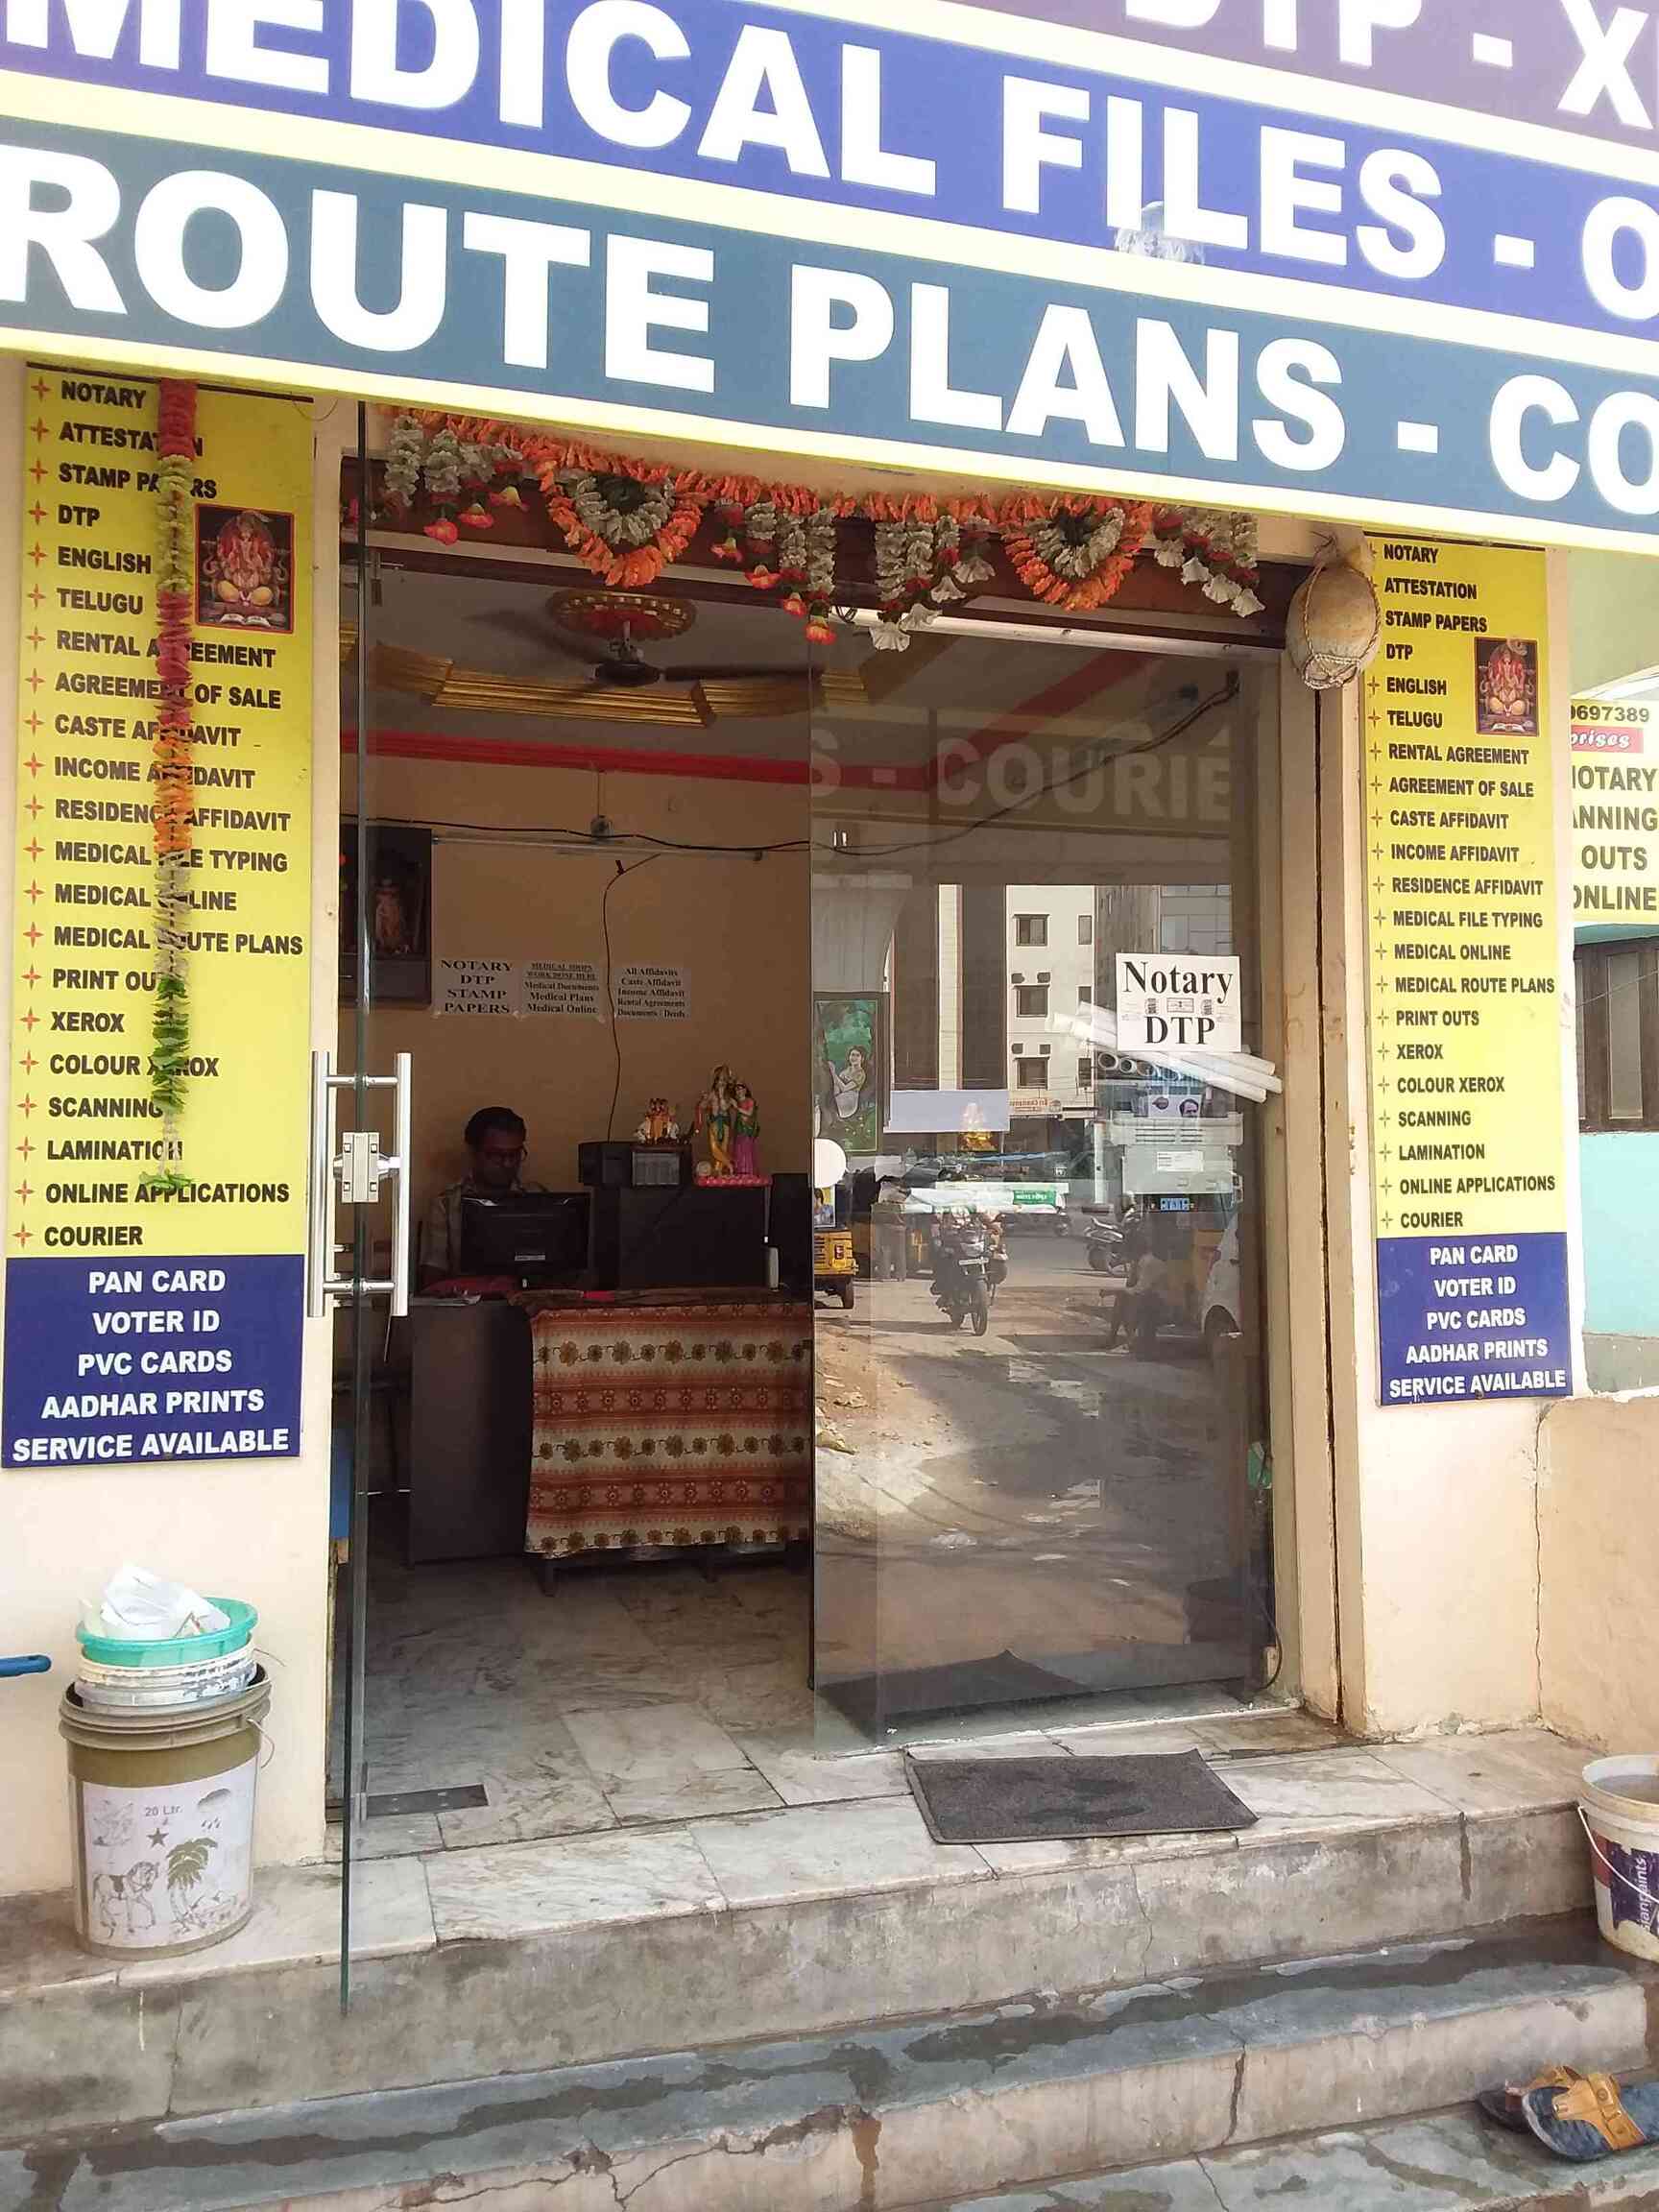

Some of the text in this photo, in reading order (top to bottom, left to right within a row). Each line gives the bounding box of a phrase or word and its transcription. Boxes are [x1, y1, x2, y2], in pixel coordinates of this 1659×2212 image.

[1002, 74, 1448, 280] FILES
[1494, 233, 1535, 269] -
[0, 144, 1659, 517] ROUTE PLANS - CO
[61, 380, 146, 409] NOTARY
[59, 422, 204, 457] ATTESTAN
[59, 464, 217, 499] STAMP PARS
[58, 504, 101, 527] DTP
[58, 545, 152, 574] ENGLISH
[1383, 543, 1439, 565] NOTARY
[1383, 577, 1478, 599] ATTESTATION
[57, 588, 144, 614] TELUGU
[1385, 610, 1488, 633] STAMP PAPERS
[57, 630, 276, 668] RENTAL AEEMENT
[1385, 644, 1413, 661] DTP
[55, 672, 281, 709] AGREEME OF SALE
[1386, 677, 1447, 696] ENGLISH
[55, 714, 126, 739] CASTE
[1386, 710, 1443, 729] TELUGU
[1388, 743, 1529, 765] RENTAL AGREEMENT
[54, 757, 255, 789] INCOME ADAVIT
[1572, 764, 1659, 792] OTARY
[1389, 777, 1534, 798] AGREEMENT OF SALE
[55, 799, 291, 831] RESIDEN AFFIDAVIT
[1390, 809, 1509, 830] CASTE AFFIDAVIT
[56, 841, 152, 866] MEDICAL
[209, 850, 288, 873] TYPING
[1391, 844, 1520, 863] INCOME AFFIDAVIT
[1581, 844, 1648, 871] OUTS
[55, 883, 238, 911] MEDICAL LINE
[1392, 877, 1544, 896] RESIDENCE AFFIDAVIT
[1393, 910, 1544, 928] MEDICAL FILE TYPING
[54, 926, 151, 950] MEDICAL
[234, 934, 303, 955] PLANS
[1394, 944, 1511, 961] MEDICAL ONLINE
[441, 960, 512, 972] NOTARY
[52, 969, 119, 990] PRINT
[461, 974, 495, 985] DTP
[524, 981, 556, 990] Medical
[1122, 961, 1234, 1004] Notary
[1395, 977, 1555, 994] MEDICAL ROUTE PLANS
[447, 989, 507, 999] STAMP
[530, 992, 593, 1002] Medical Plans
[445, 1002, 510, 1014] PAPERS
[528, 1003, 598, 1014] Medical Online
[1396, 1010, 1479, 1026] PRINT OUTS
[50, 1012, 125, 1034] XEROX
[1143, 1016, 1215, 1045] DTP
[1396, 1044, 1444, 1060] XEROX
[50, 1054, 220, 1077] COLOUR XOX
[1397, 1076, 1505, 1094] COLOUR XEROX
[48, 1096, 164, 1118] SCANNING
[1398, 1110, 1472, 1127] SCANNING
[47, 1140, 183, 1161] LAMINATION
[1399, 1143, 1485, 1162] LAMINATION
[45, 1182, 290, 1204] ONLINE APPLICATIONS
[1400, 1175, 1556, 1195] ONLINE APPLICATIONS
[1400, 1211, 1463, 1229] COURIER
[43, 1225, 144, 1246] COURIER
[1430, 1244, 1519, 1265] PAN CARD
[88, 1269, 226, 1294] PAN CARD
[1434, 1276, 1516, 1298] VOTER ID
[92, 1309, 221, 1334] VOTER ID
[1427, 1308, 1527, 1330] PVC CARDS
[1406, 1338, 1549, 1365] AADHAR PRINTS
[78, 1349, 233, 1377] PVC CARDS
[1389, 1370, 1567, 1398] SERVICE AVAILABLE
[40, 1388, 266, 1419] AADHAR PRINTS
[12, 1428, 290, 1462] SERVICE AVAILABLE
[145, 1807, 158, 1816] 20
